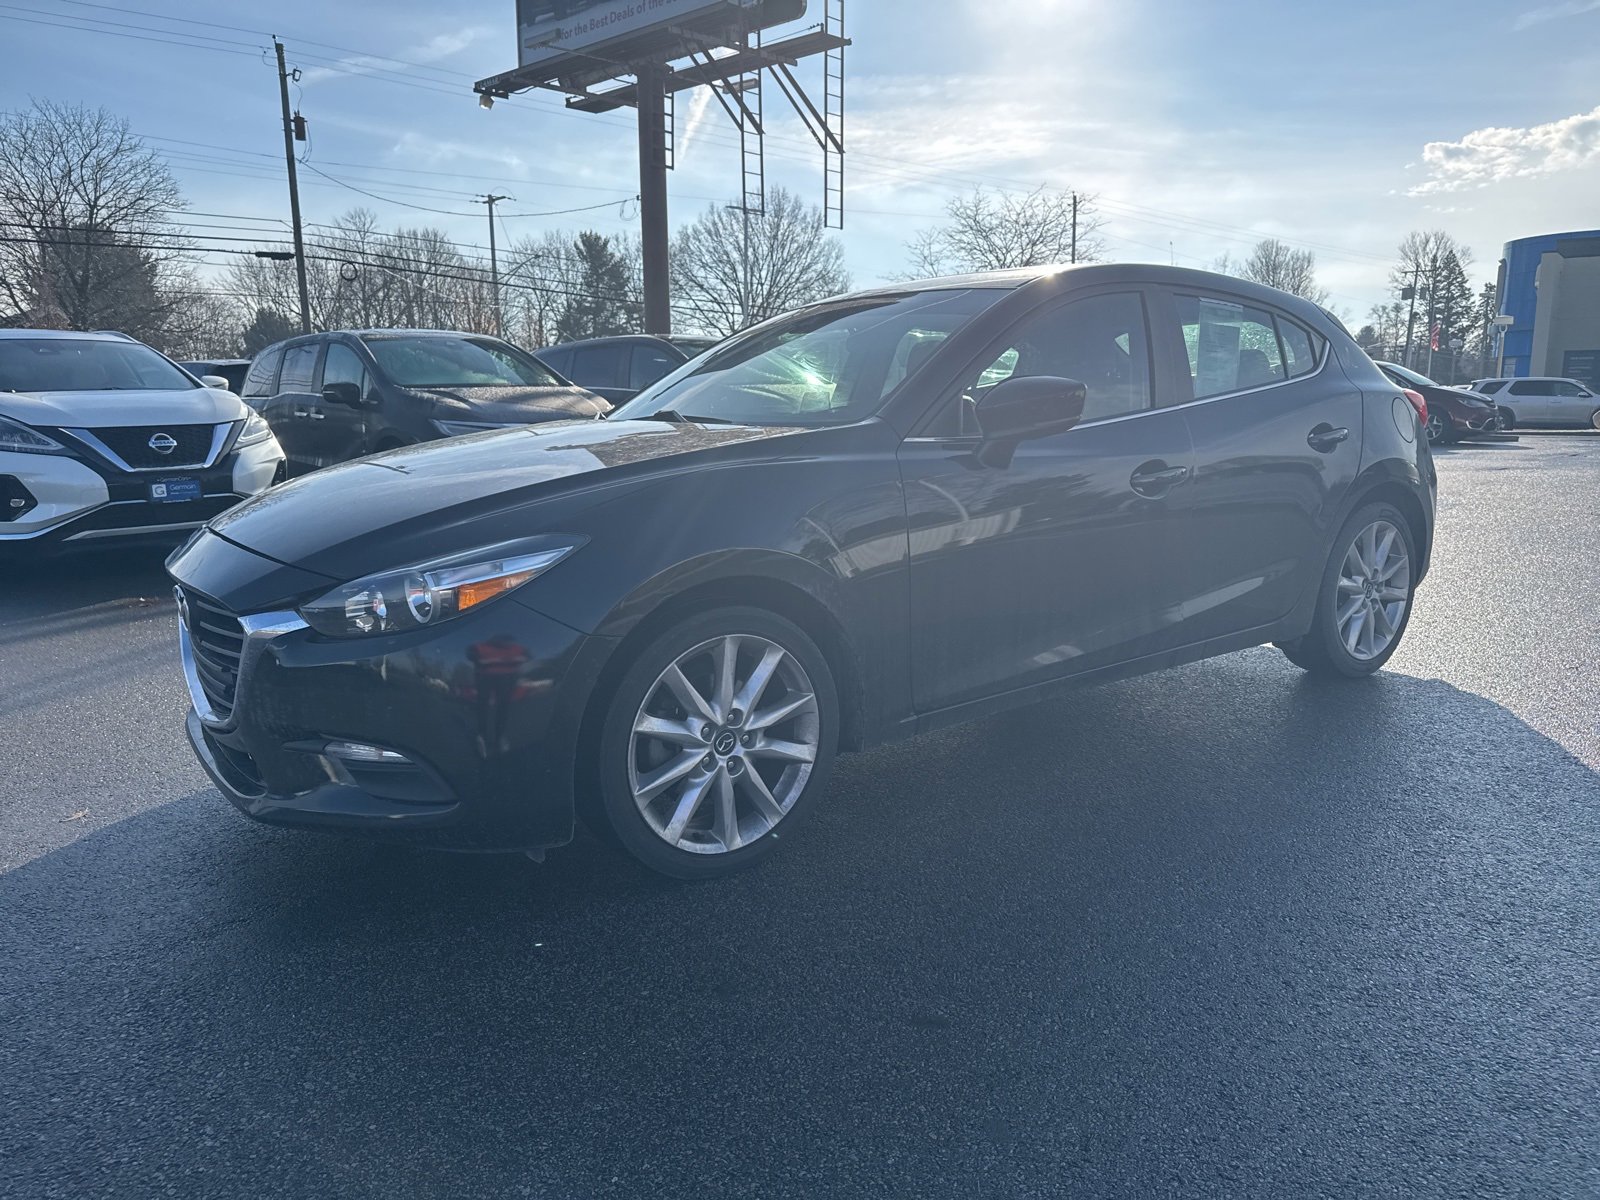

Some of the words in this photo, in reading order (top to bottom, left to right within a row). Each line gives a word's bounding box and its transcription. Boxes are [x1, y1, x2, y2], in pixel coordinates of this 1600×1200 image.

[574, 22, 588, 36] the
[590, 15, 609, 31] Best
[610, 5, 634, 24] Deals
[636, 0, 646, 14] of
